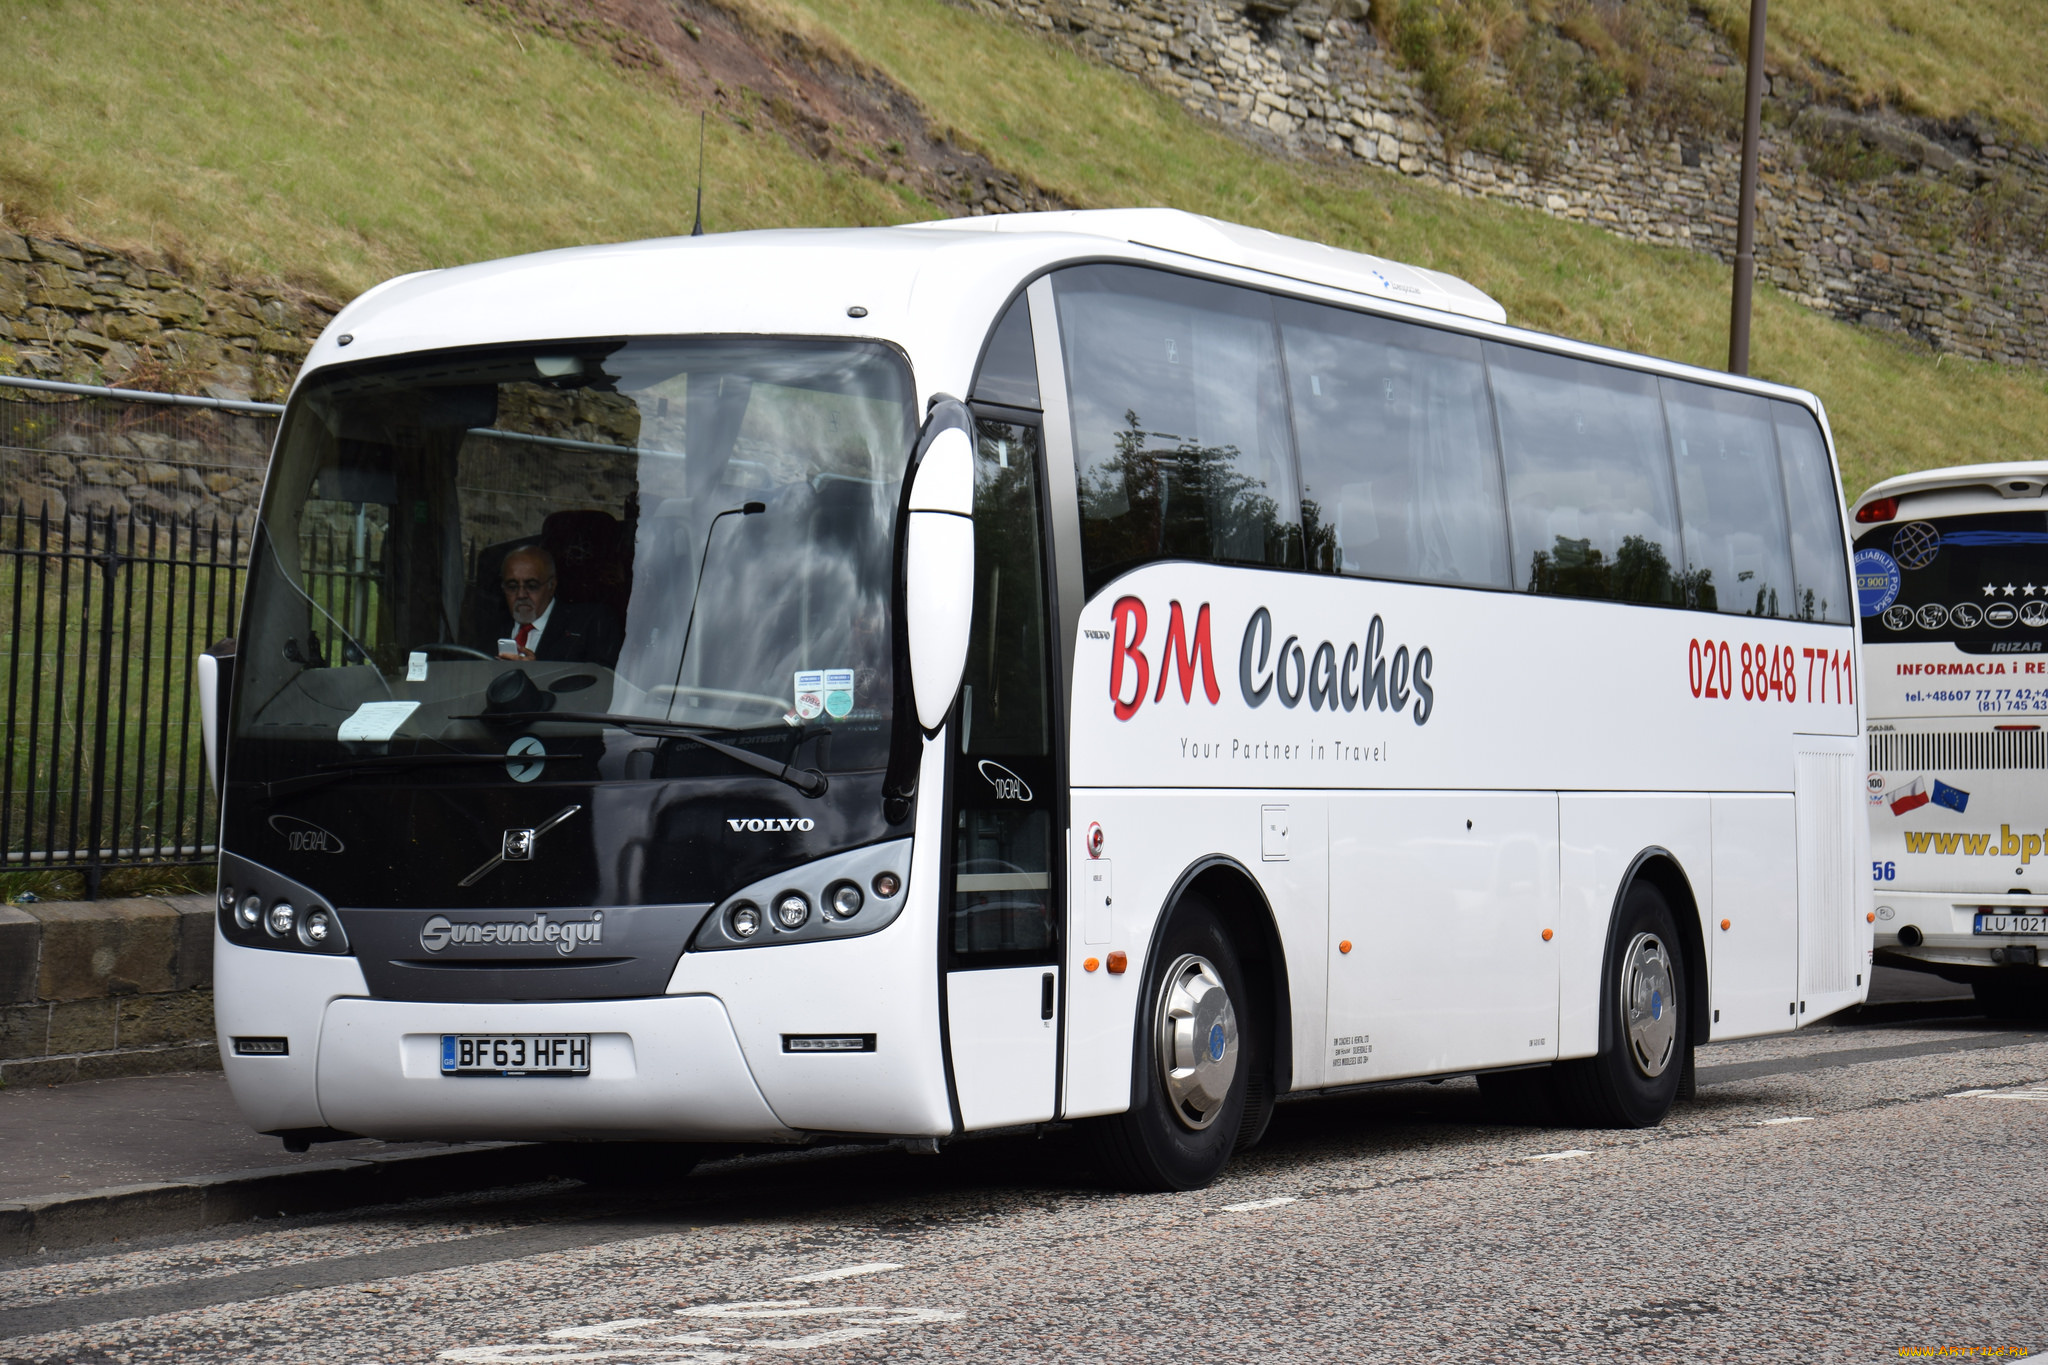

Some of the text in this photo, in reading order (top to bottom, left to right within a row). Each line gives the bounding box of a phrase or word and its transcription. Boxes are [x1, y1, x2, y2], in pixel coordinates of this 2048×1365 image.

[1855, 551, 1898, 611] ELIABILITY POLSKA
[1867, 577, 1888, 587] 9001
[1991, 642, 2042, 652] IRIZAR
[1109, 594, 1434, 726] BM Coaches
[1896, 662, 2048, 675] INFORMACJA i RE
[1689, 638, 1853, 705] 020 8848 7711
[1905, 690, 1971, 702] tel.+48607
[1975, 689, 1991, 700] 77
[1995, 689, 2011, 700] 77
[1978, 700, 2047, 712] (81) 745 43
[1180, 738, 1387, 762] Your Partner in Travel
[994, 778, 1022, 799] SIDERAL
[1869, 778, 1882, 788] 100
[727, 819, 815, 832] VOLVO
[288, 830, 328, 851] SIDERAL
[1872, 861, 1896, 881] 56
[422, 911, 602, 954] Sunsundegui
[1985, 917, 2006, 931] LU
[2012, 917, 2047, 931] 1021
[459, 1040, 585, 1066] BF63 HFH
